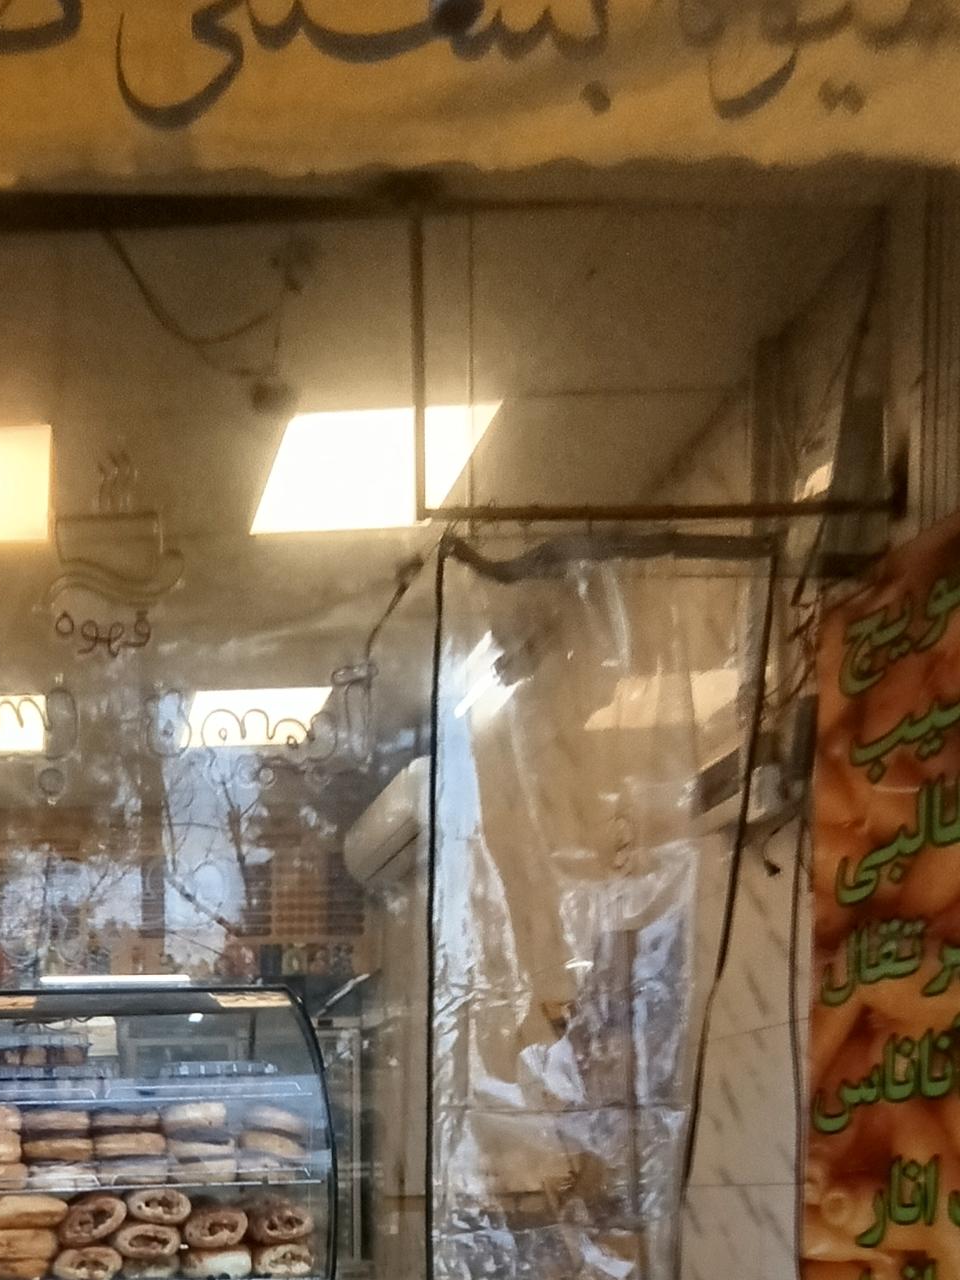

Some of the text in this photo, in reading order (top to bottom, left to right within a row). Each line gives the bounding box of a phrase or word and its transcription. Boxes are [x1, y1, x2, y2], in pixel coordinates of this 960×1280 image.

[840, 578, 960, 695] ویج
[836, 775, 960, 906] البی
[814, 1025, 960, 1133] ناناس
[854, 1153, 939, 1248] انار
